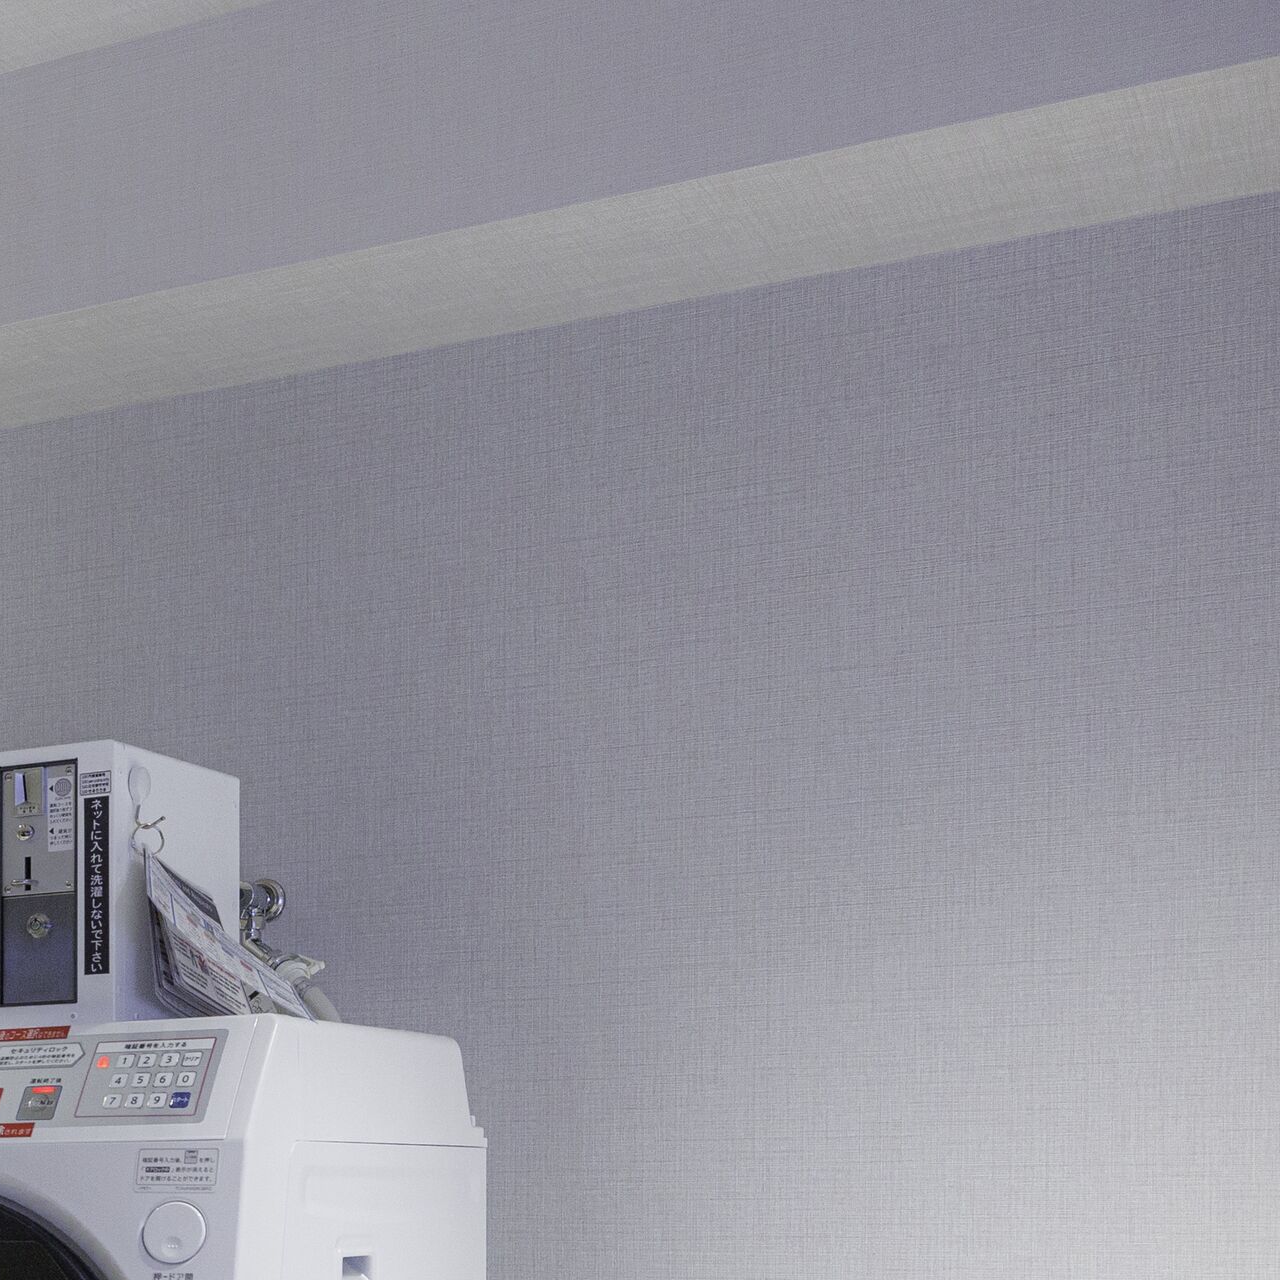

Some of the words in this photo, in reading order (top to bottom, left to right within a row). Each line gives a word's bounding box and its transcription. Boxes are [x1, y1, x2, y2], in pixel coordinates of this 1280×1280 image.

[90, 798, 104, 972] ネットに入れて洗濯しないで下さい
[143, 1056, 150, 1064] 2
[165, 1055, 172, 1064] 3
[114, 1076, 121, 1084] 4
[136, 1075, 143, 1084] 5
[159, 1075, 166, 1083] 6
[182, 1074, 189, 1083] 0
[109, 1097, 116, 1105] 7
[131, 1097, 138, 1105] 8
[153, 1096, 160, 1104] 9
